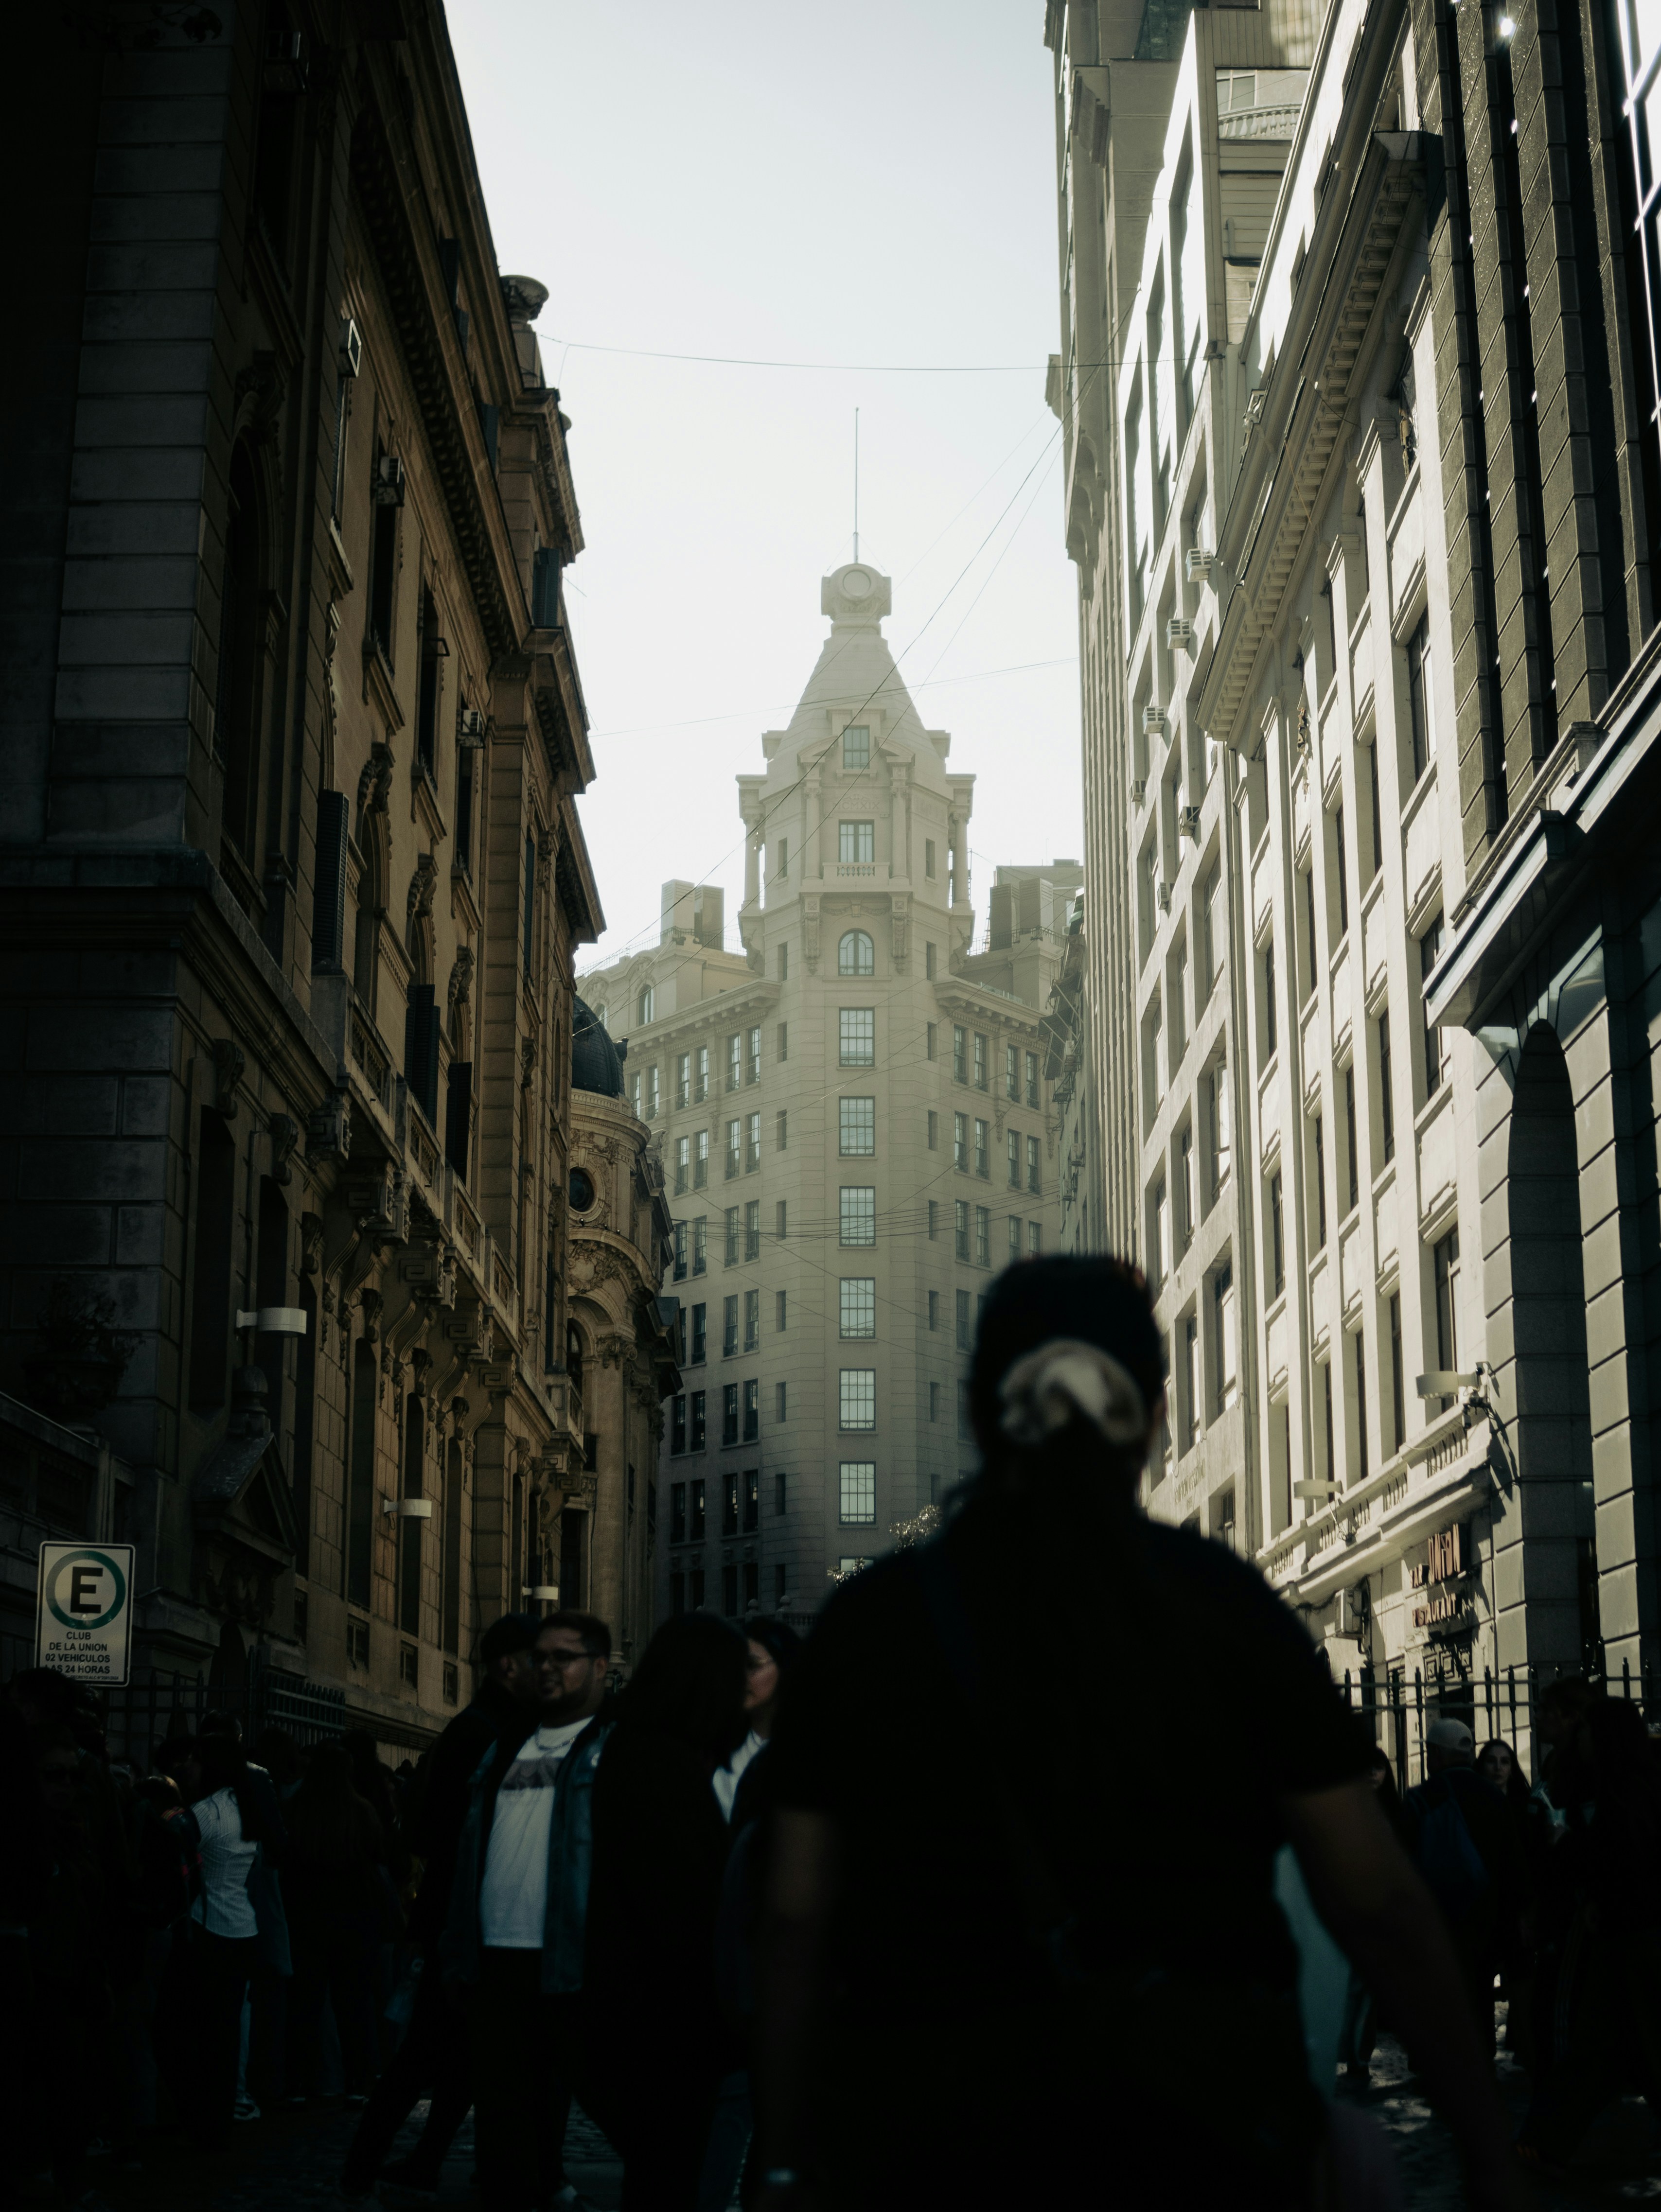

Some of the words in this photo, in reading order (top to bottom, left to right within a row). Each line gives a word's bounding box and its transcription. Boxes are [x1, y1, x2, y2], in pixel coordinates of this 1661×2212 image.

[832, 802, 880, 810] MCMXIX
[1428, 1523, 1461, 1584] UNION
[70, 1566, 103, 1614] E
[66, 1631, 91, 1640] CLUB
[49, 1642, 62, 1650] DE
[64, 1643, 76, 1651] LA
[79, 1643, 107, 1651] UNION
[45, 1653, 56, 1662] 02
[58, 1653, 110, 1663] VEHICULOS
[65, 1665, 75, 1673] 24
[78, 1665, 110, 1674] HORAS
